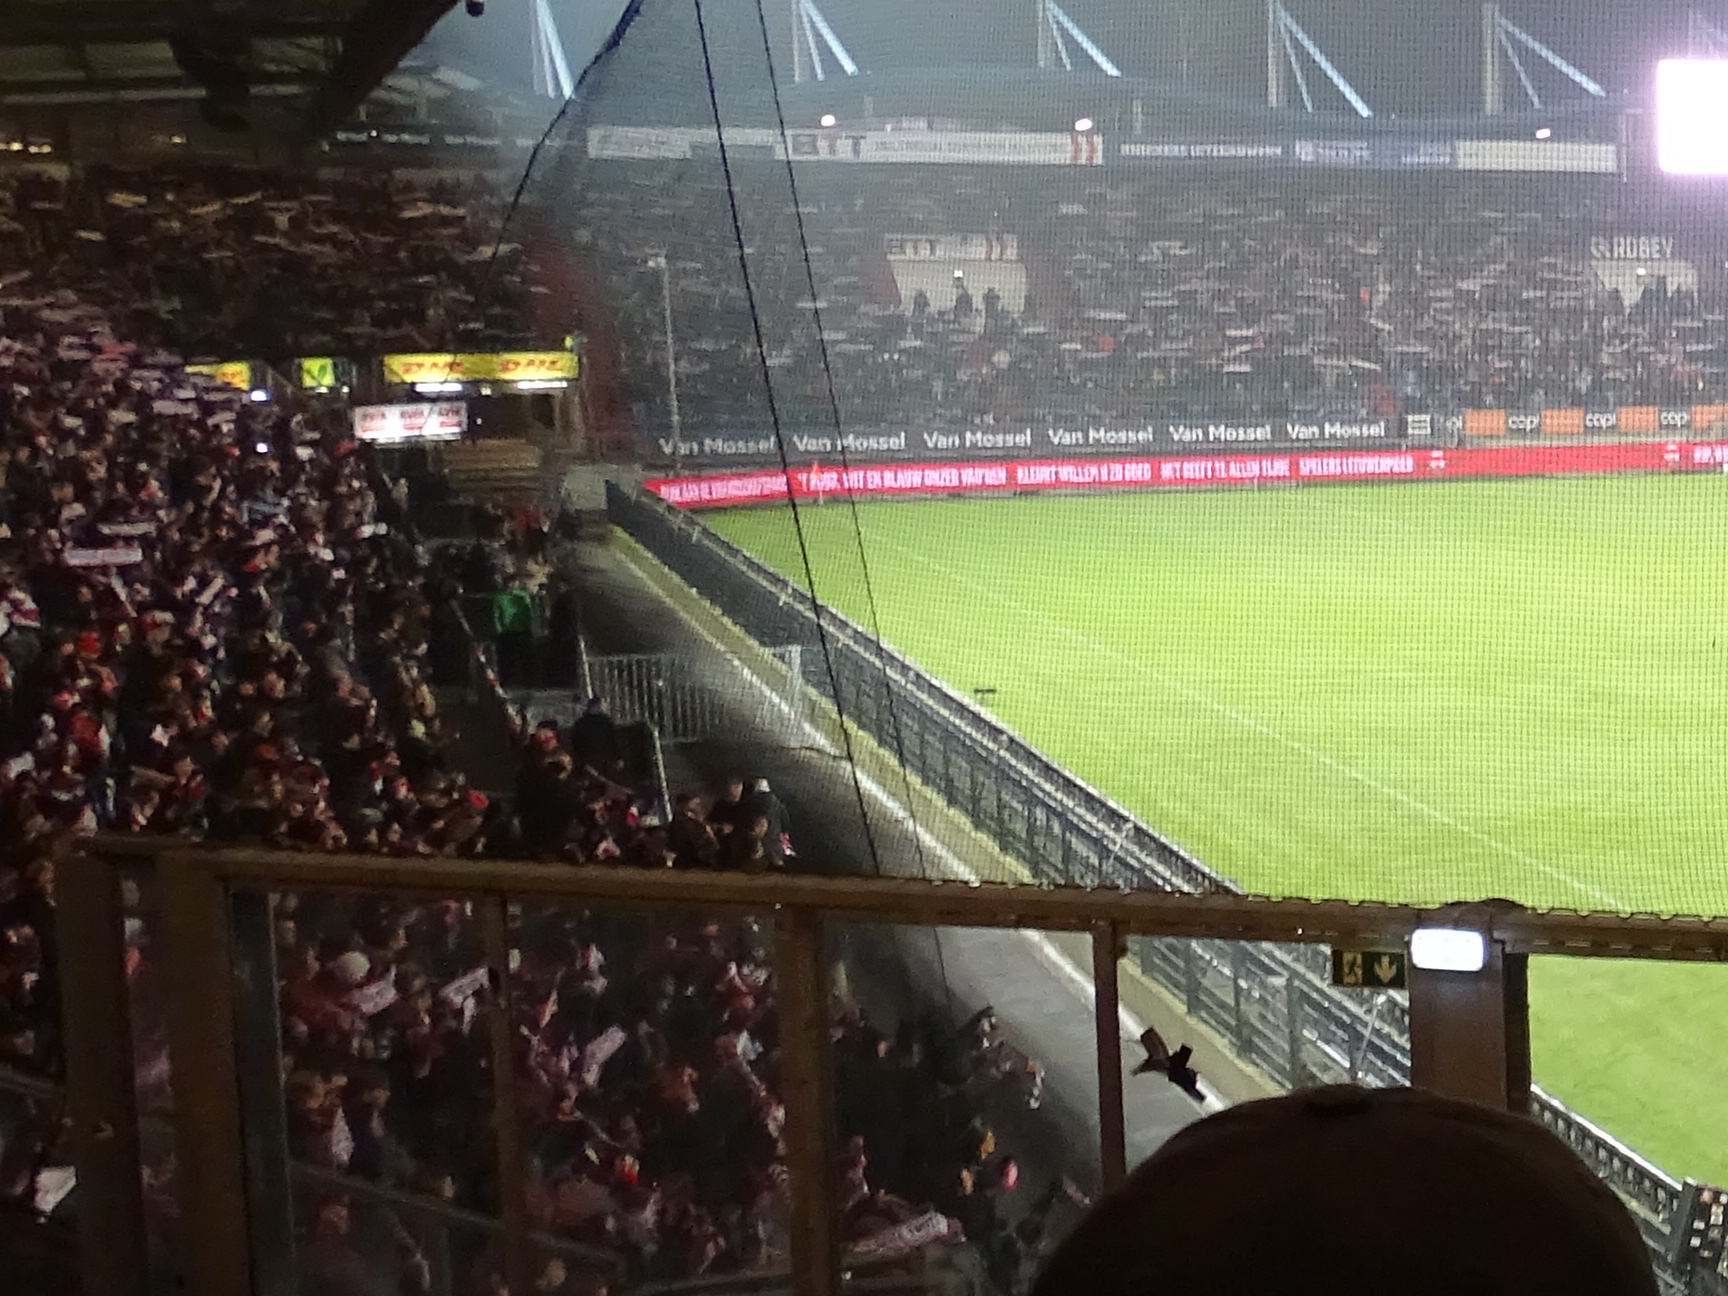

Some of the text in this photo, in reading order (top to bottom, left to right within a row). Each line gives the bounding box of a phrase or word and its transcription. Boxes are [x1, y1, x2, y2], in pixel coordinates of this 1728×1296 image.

[923, 427, 1032, 450] Van Mossel
[1047, 425, 1154, 446] Van Mossel
[1169, 423, 1272, 443] Van Mossel
[1286, 420, 1385, 440] Van Mossel
[792, 431, 906, 453] Van Mossel
